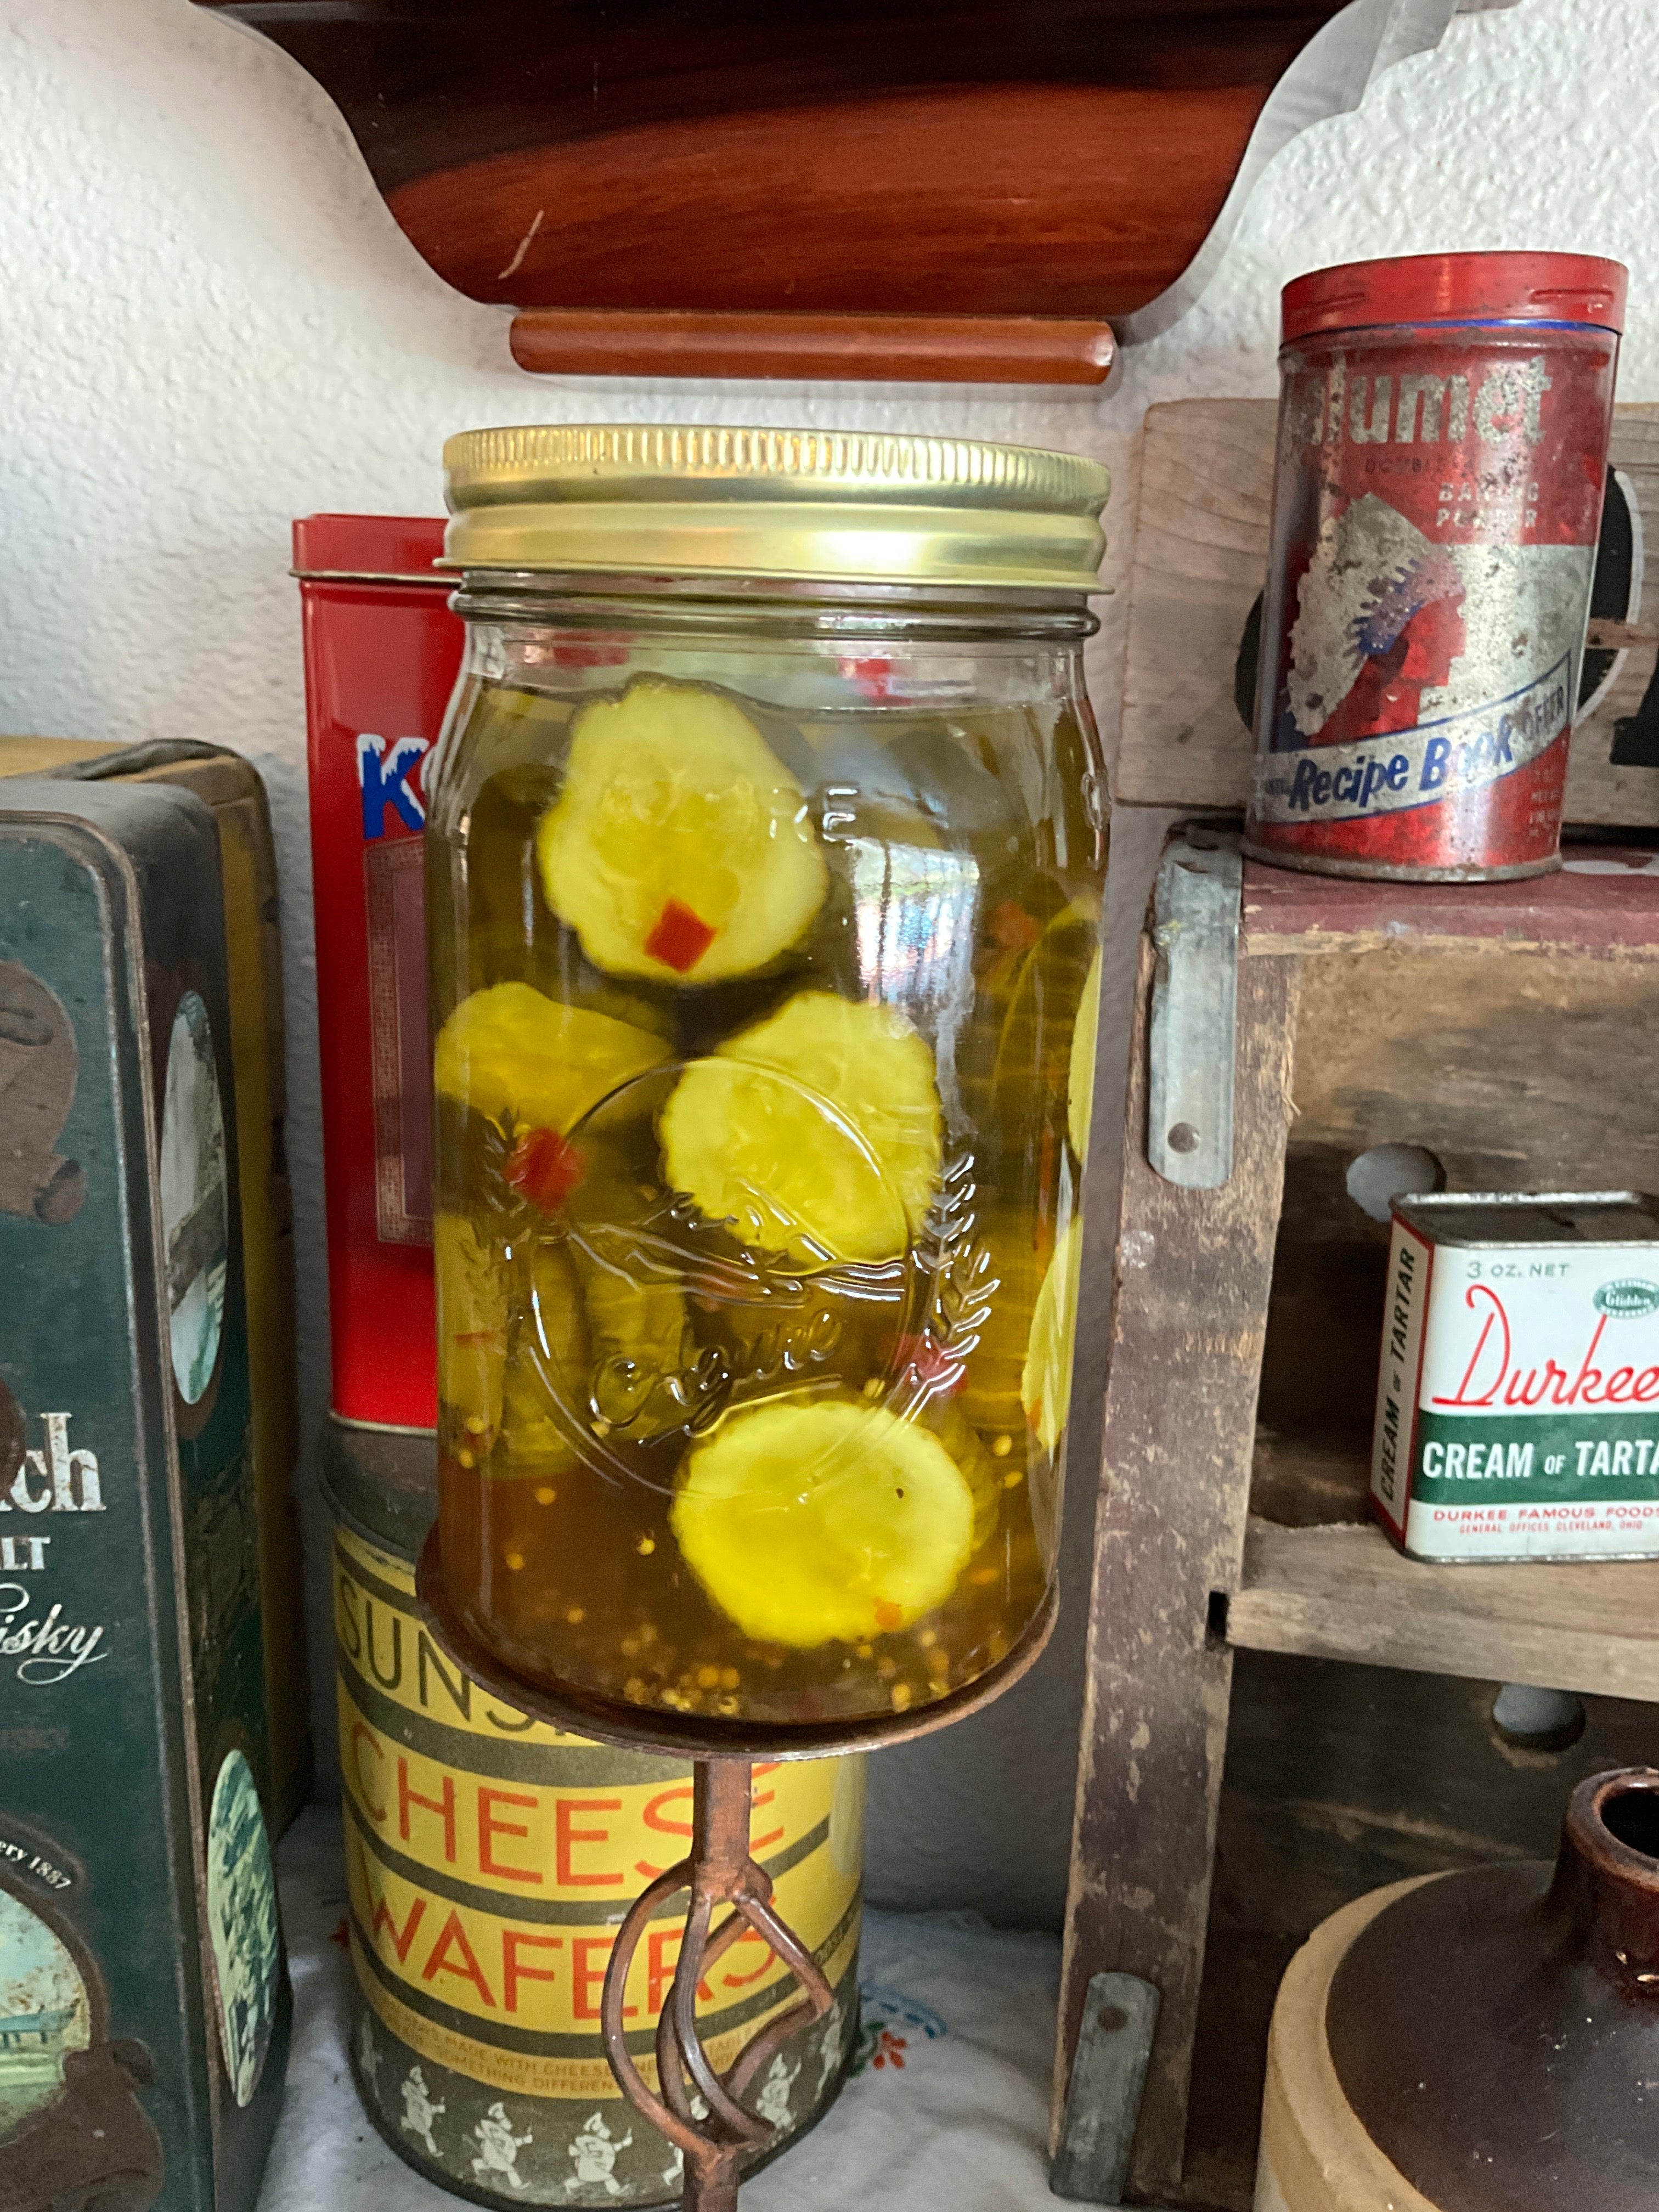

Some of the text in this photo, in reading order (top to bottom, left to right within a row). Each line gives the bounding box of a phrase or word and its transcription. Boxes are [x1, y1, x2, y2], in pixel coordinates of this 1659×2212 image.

[1306, 349, 1553, 445] lumet
[356, 733, 435, 840] K
[1289, 754, 1409, 811] Recipe
[1419, 713, 1514, 791] Book
[1390, 1248, 1415, 1363] TARTAR
[1466, 1261, 1570, 1279] 3 OZ. NET
[1432, 1284, 1659, 1406] Durkee
[0, 1413, 106, 1513] ch
[1380, 1394, 1401, 1501] CREAM
[1423, 1442, 1533, 1479] CREAM
[1544, 1455, 1566, 1476] OF
[1433, 1506, 1659, 1522] DURKEE FAMOUS FOOD
[1459, 1523, 1502, 1534] GENERAL
[1510, 1521, 1549, 1532] OFFICES
[1620, 1519, 1643, 1530] OHIO
[339, 1575, 565, 1736] SUN
[29, 1856, 72, 1889] 1887
[496, 2056, 537, 2075] WITH
[533, 2077, 613, 2092] DIFFEREN
